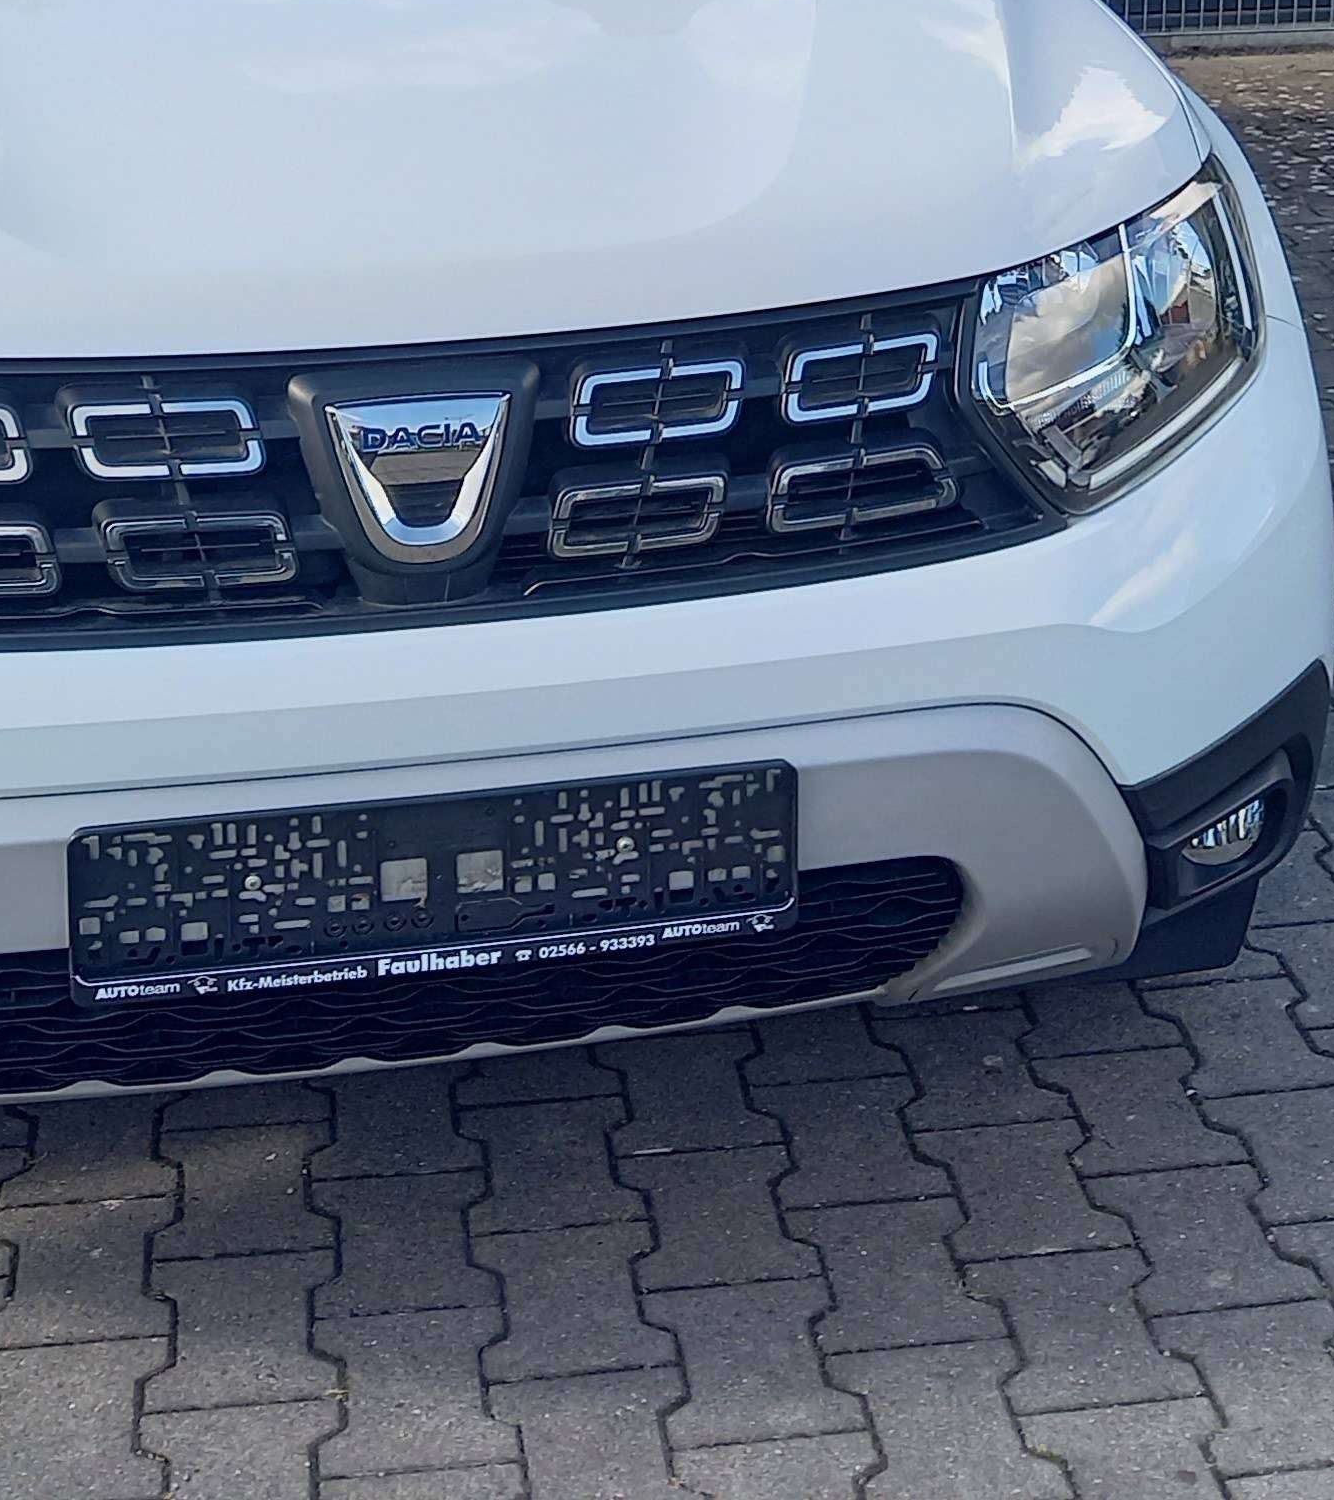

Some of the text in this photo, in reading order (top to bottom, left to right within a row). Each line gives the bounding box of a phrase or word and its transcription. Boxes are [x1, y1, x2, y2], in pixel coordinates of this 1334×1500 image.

[361, 422, 482, 450] DACIA
[95, 982, 181, 1000] AUTOteam
[227, 966, 368, 992] Kfz-Meisterbetrieb
[377, 950, 503, 976] Faulhaber
[539, 942, 586, 960] 02566
[600, 934, 656, 952] 933393
[662, 921, 740, 939] AUTOteam
